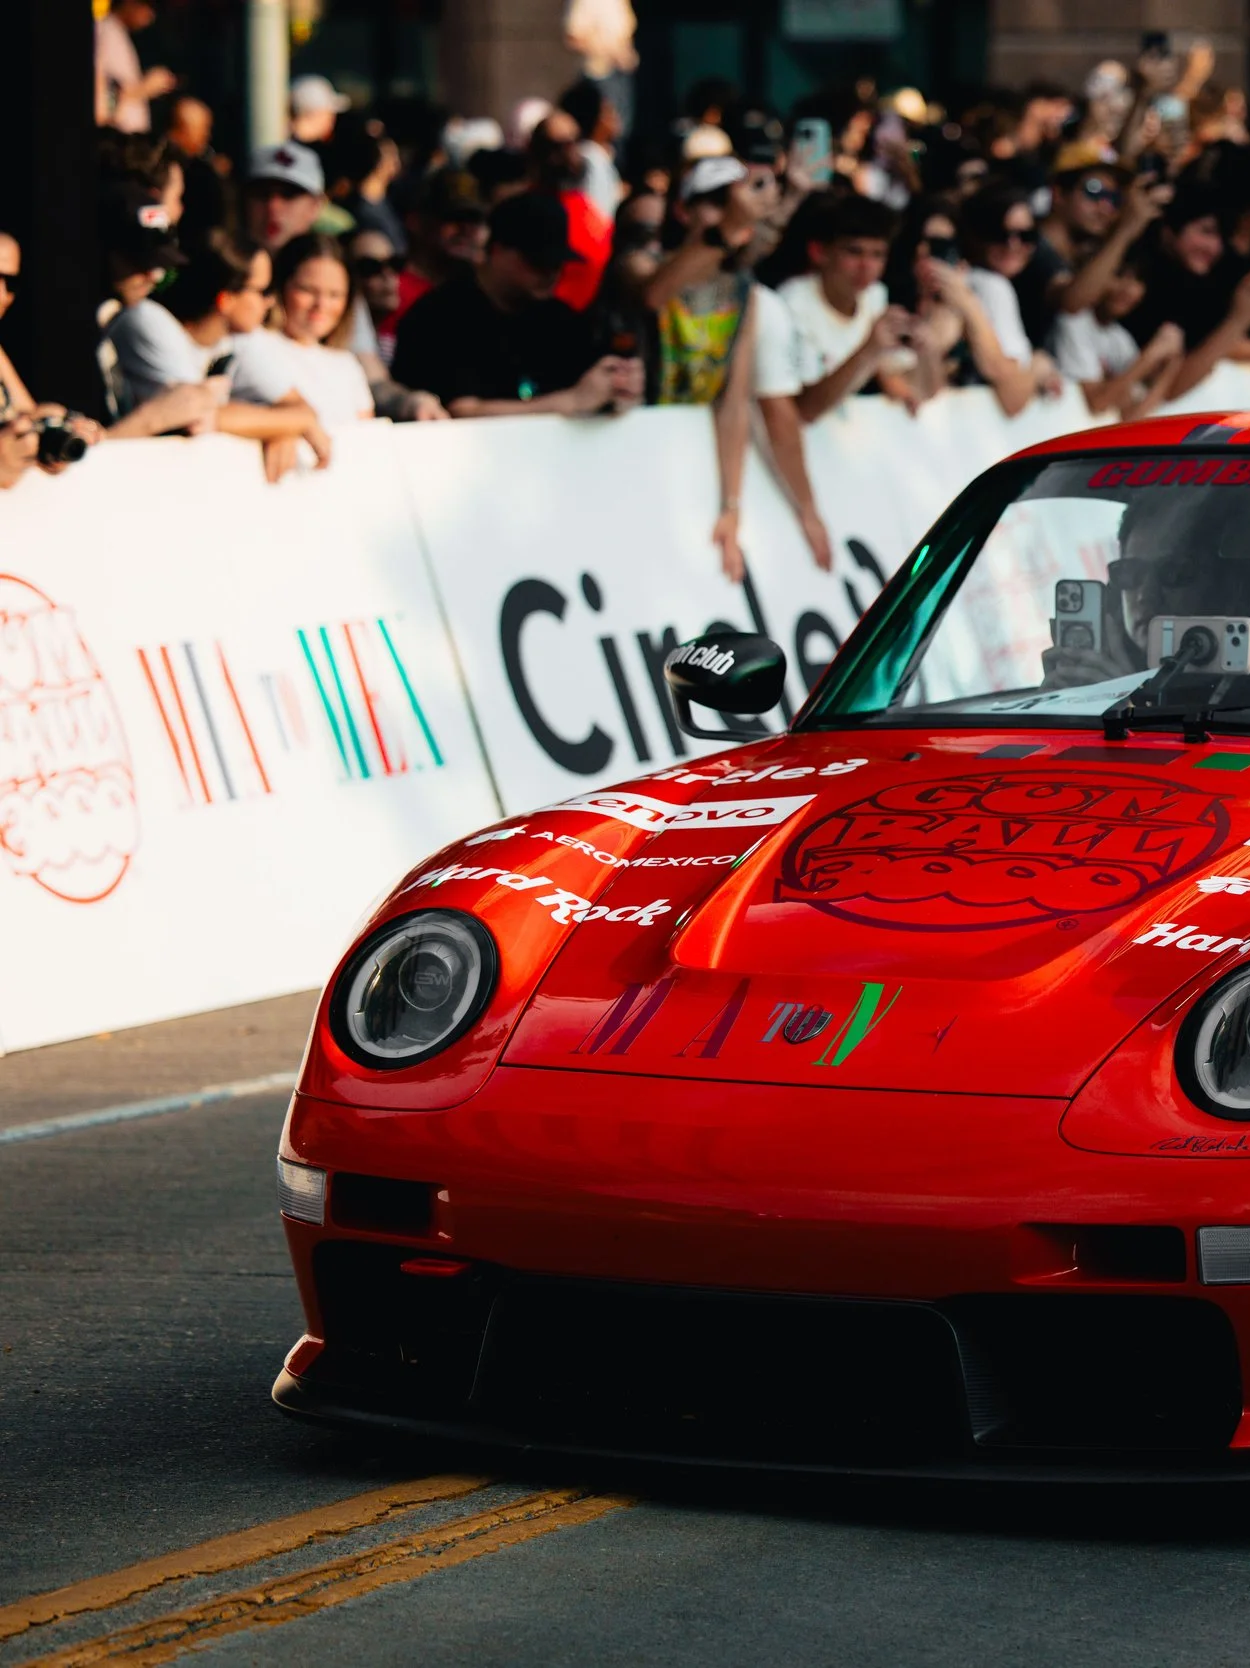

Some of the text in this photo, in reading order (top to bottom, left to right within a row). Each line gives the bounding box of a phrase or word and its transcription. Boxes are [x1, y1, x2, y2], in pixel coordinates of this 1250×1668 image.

[688, 644, 735, 675] club
[530, 832, 736, 868] AEROMEXICO
[535, 887, 672, 926] Rock
